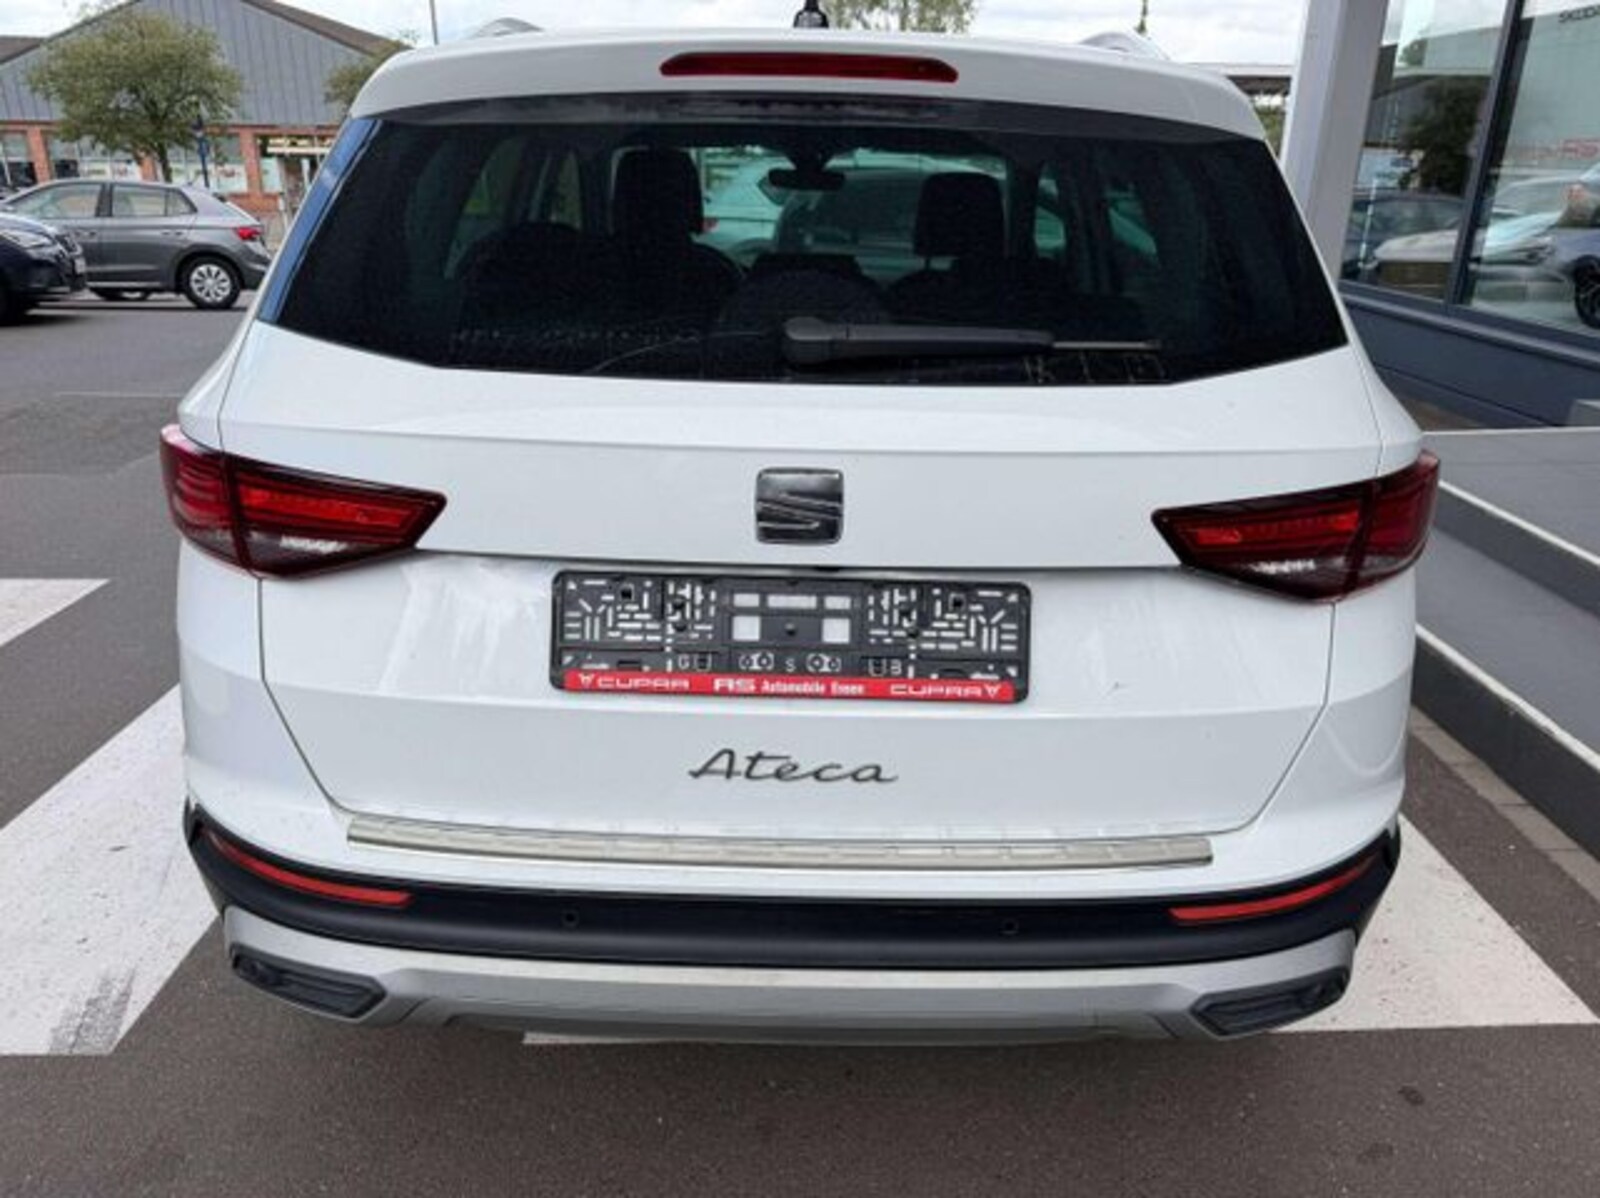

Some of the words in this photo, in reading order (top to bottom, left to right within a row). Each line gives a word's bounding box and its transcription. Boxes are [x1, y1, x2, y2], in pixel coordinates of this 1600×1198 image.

[598, 678, 690, 690] CUPRA
[890, 684, 982, 697] CUPRA
[688, 748, 899, 782] Ateca
